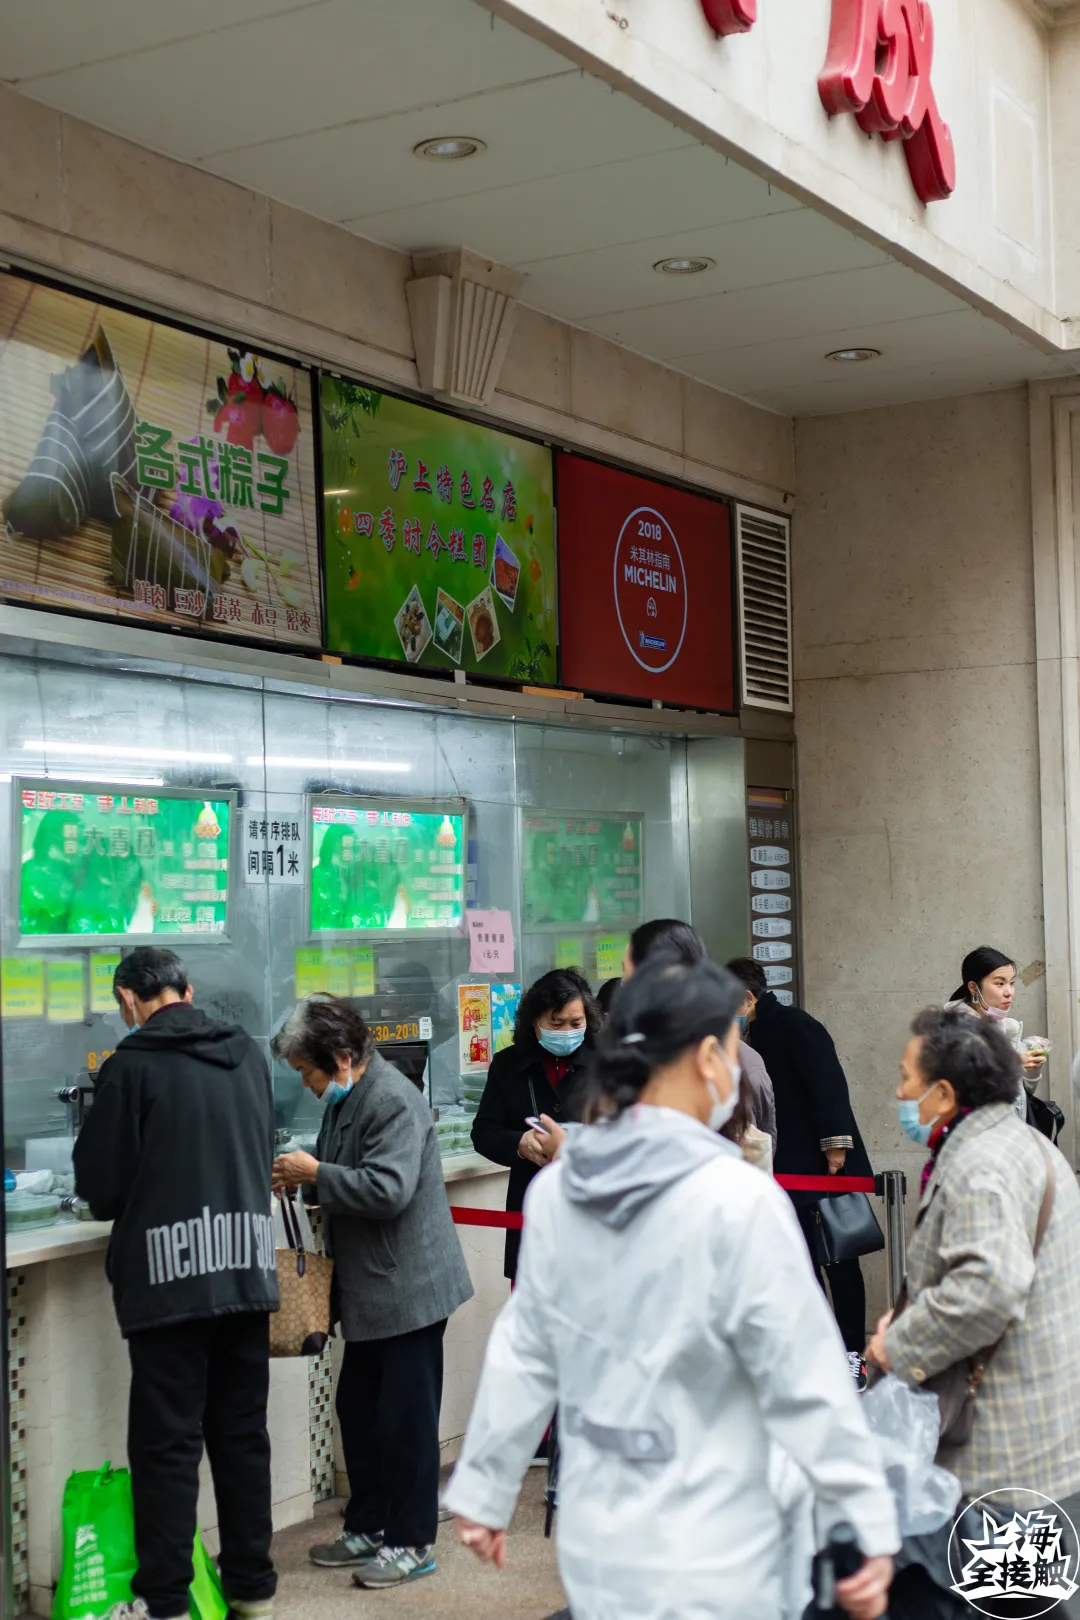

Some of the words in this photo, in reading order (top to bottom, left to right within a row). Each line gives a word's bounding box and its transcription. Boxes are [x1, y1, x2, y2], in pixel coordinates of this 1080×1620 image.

[135, 421, 291, 517] 各式粽子
[387, 447, 518, 521] 沪上特色名店
[353, 505, 488, 571] 四季时令糕团
[637, 519, 662, 541] 2018
[629, 546, 670, 571] 米其林指南
[624, 563, 677, 594] MICHELIN
[135, 579, 166, 611] 鲜肉
[174, 588, 206, 617] 豆沙
[213, 594, 242, 623] 蛋黄
[251, 601, 277, 627] 赤豆
[248, 820, 301, 841] 请有序排队
[248, 844, 299, 877] 间隔1米
